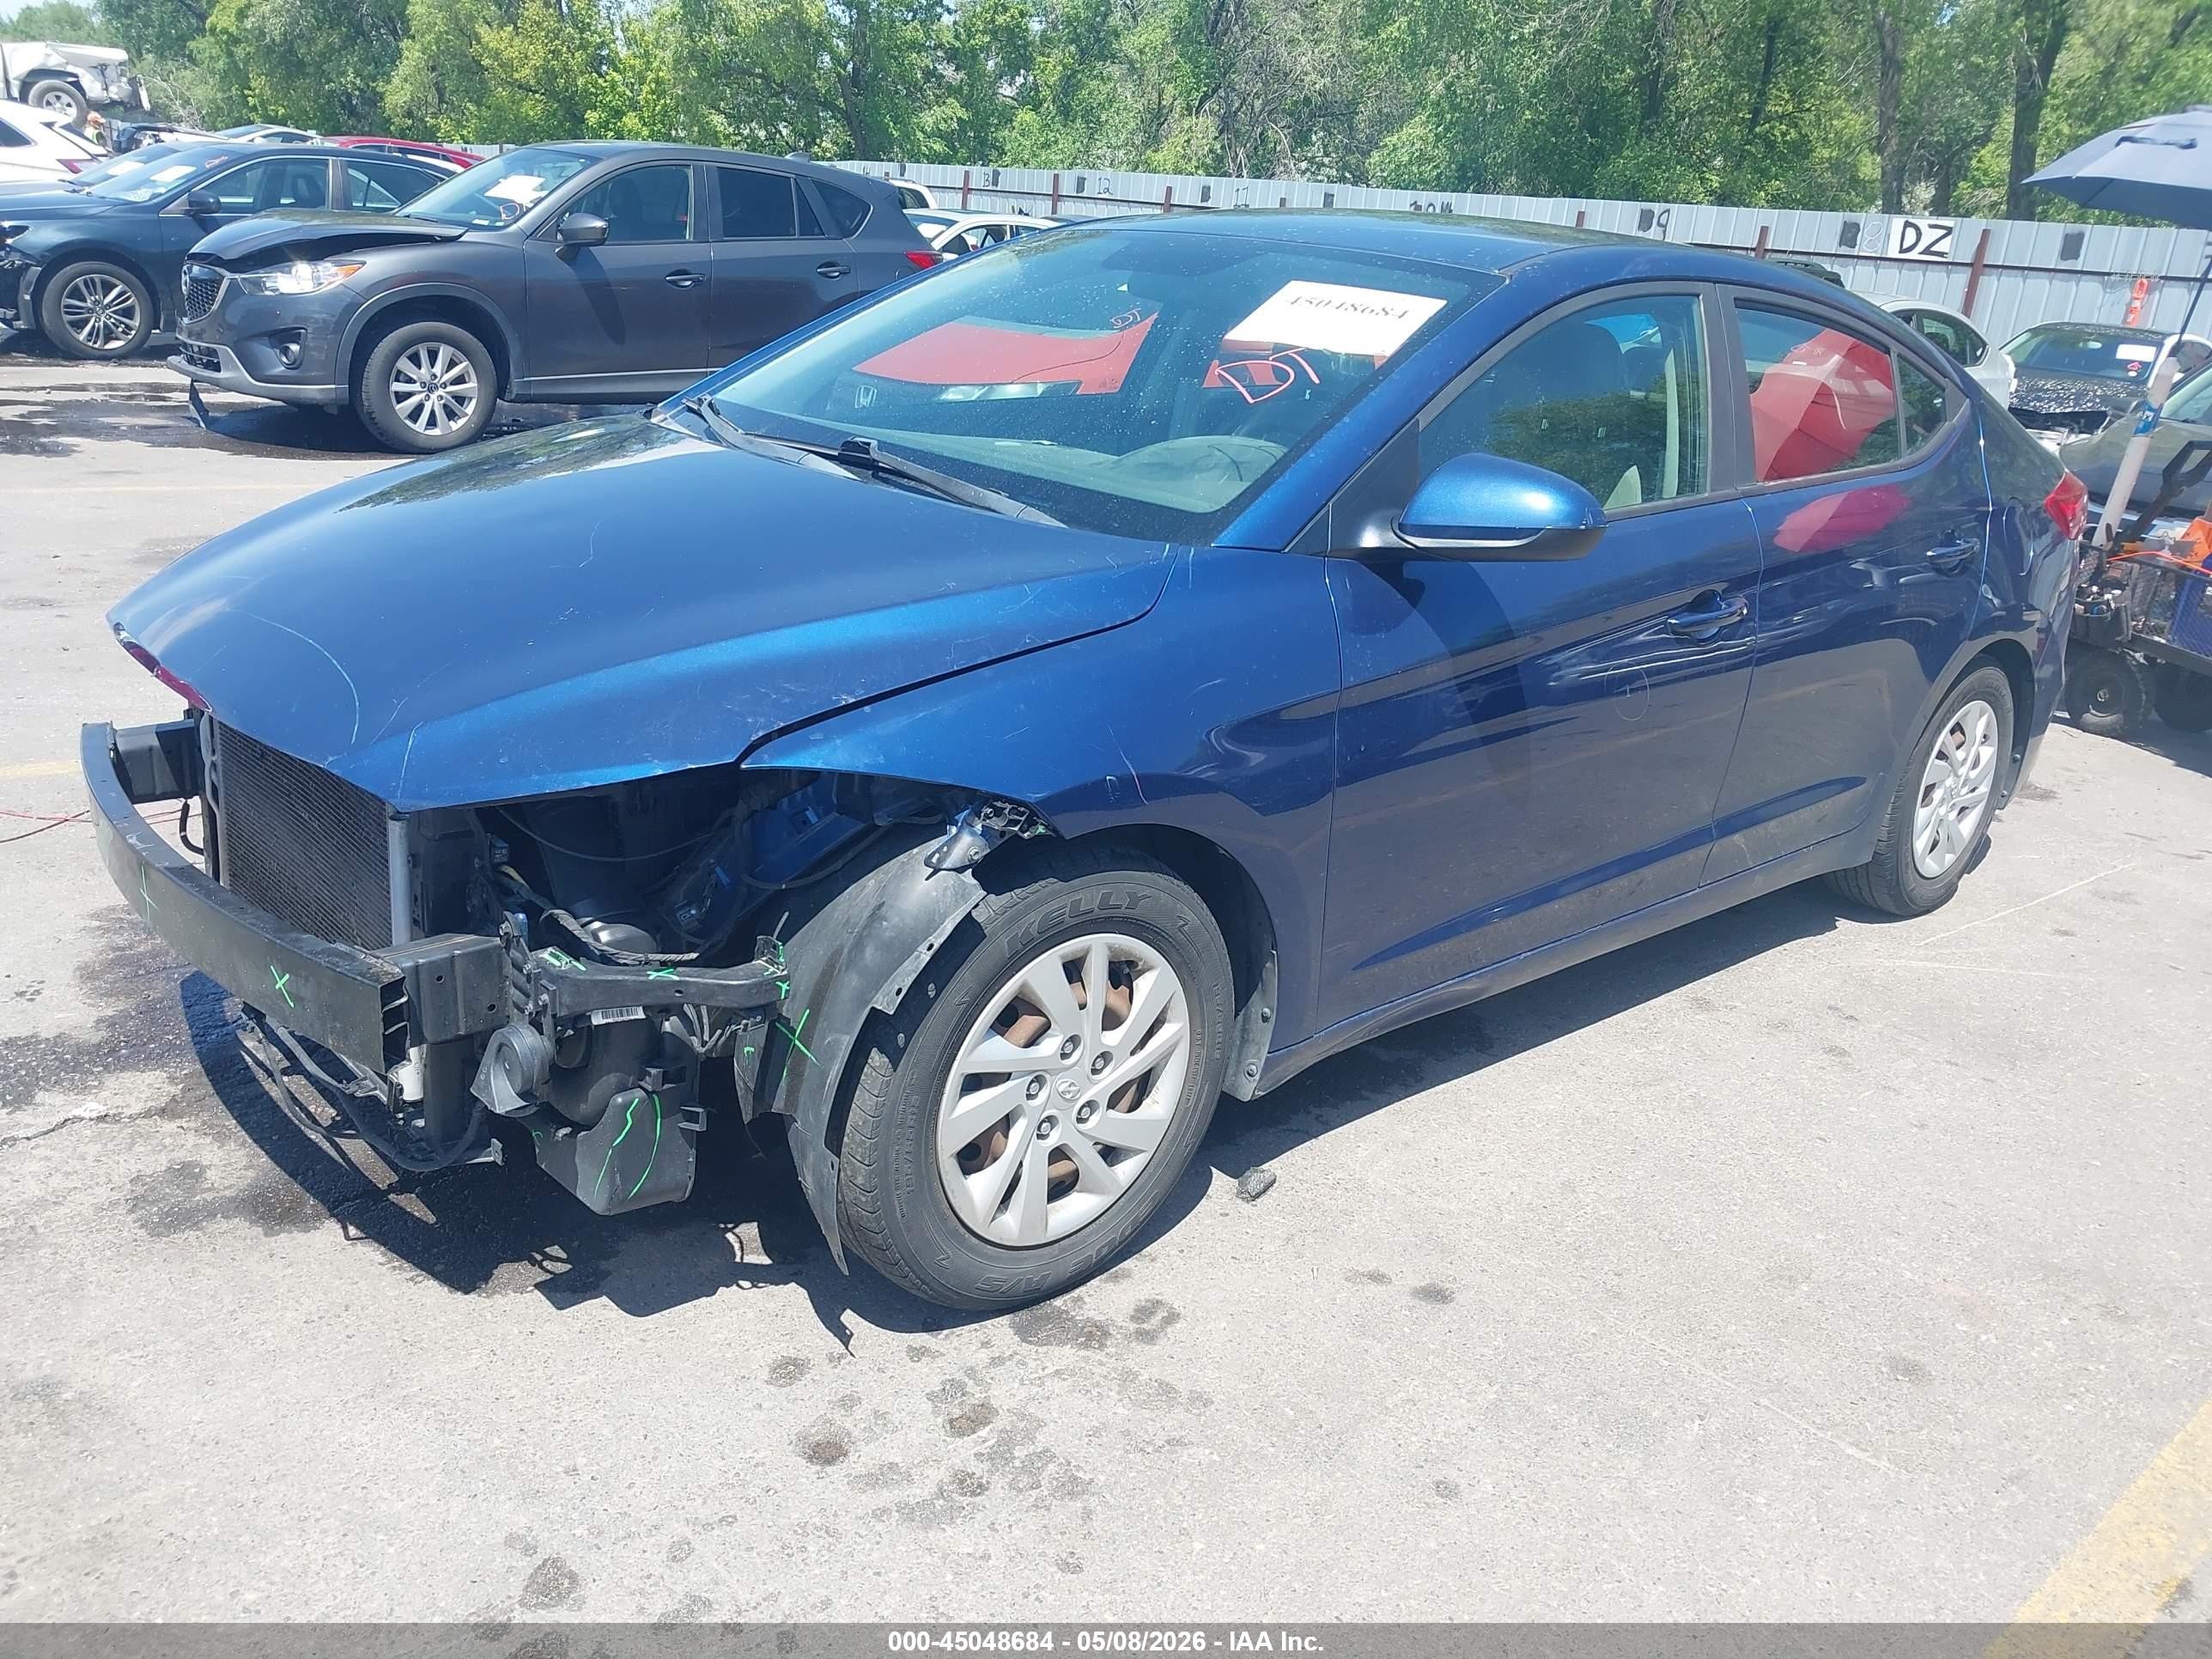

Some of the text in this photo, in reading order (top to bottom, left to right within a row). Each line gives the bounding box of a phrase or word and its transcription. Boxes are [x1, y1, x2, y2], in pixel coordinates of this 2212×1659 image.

[1097, 177, 1114, 196] 12
[1898, 220, 1954, 258] DZ
[1005, 890, 1153, 958] KELLY
[975, 1270, 1052, 1293] A/S
